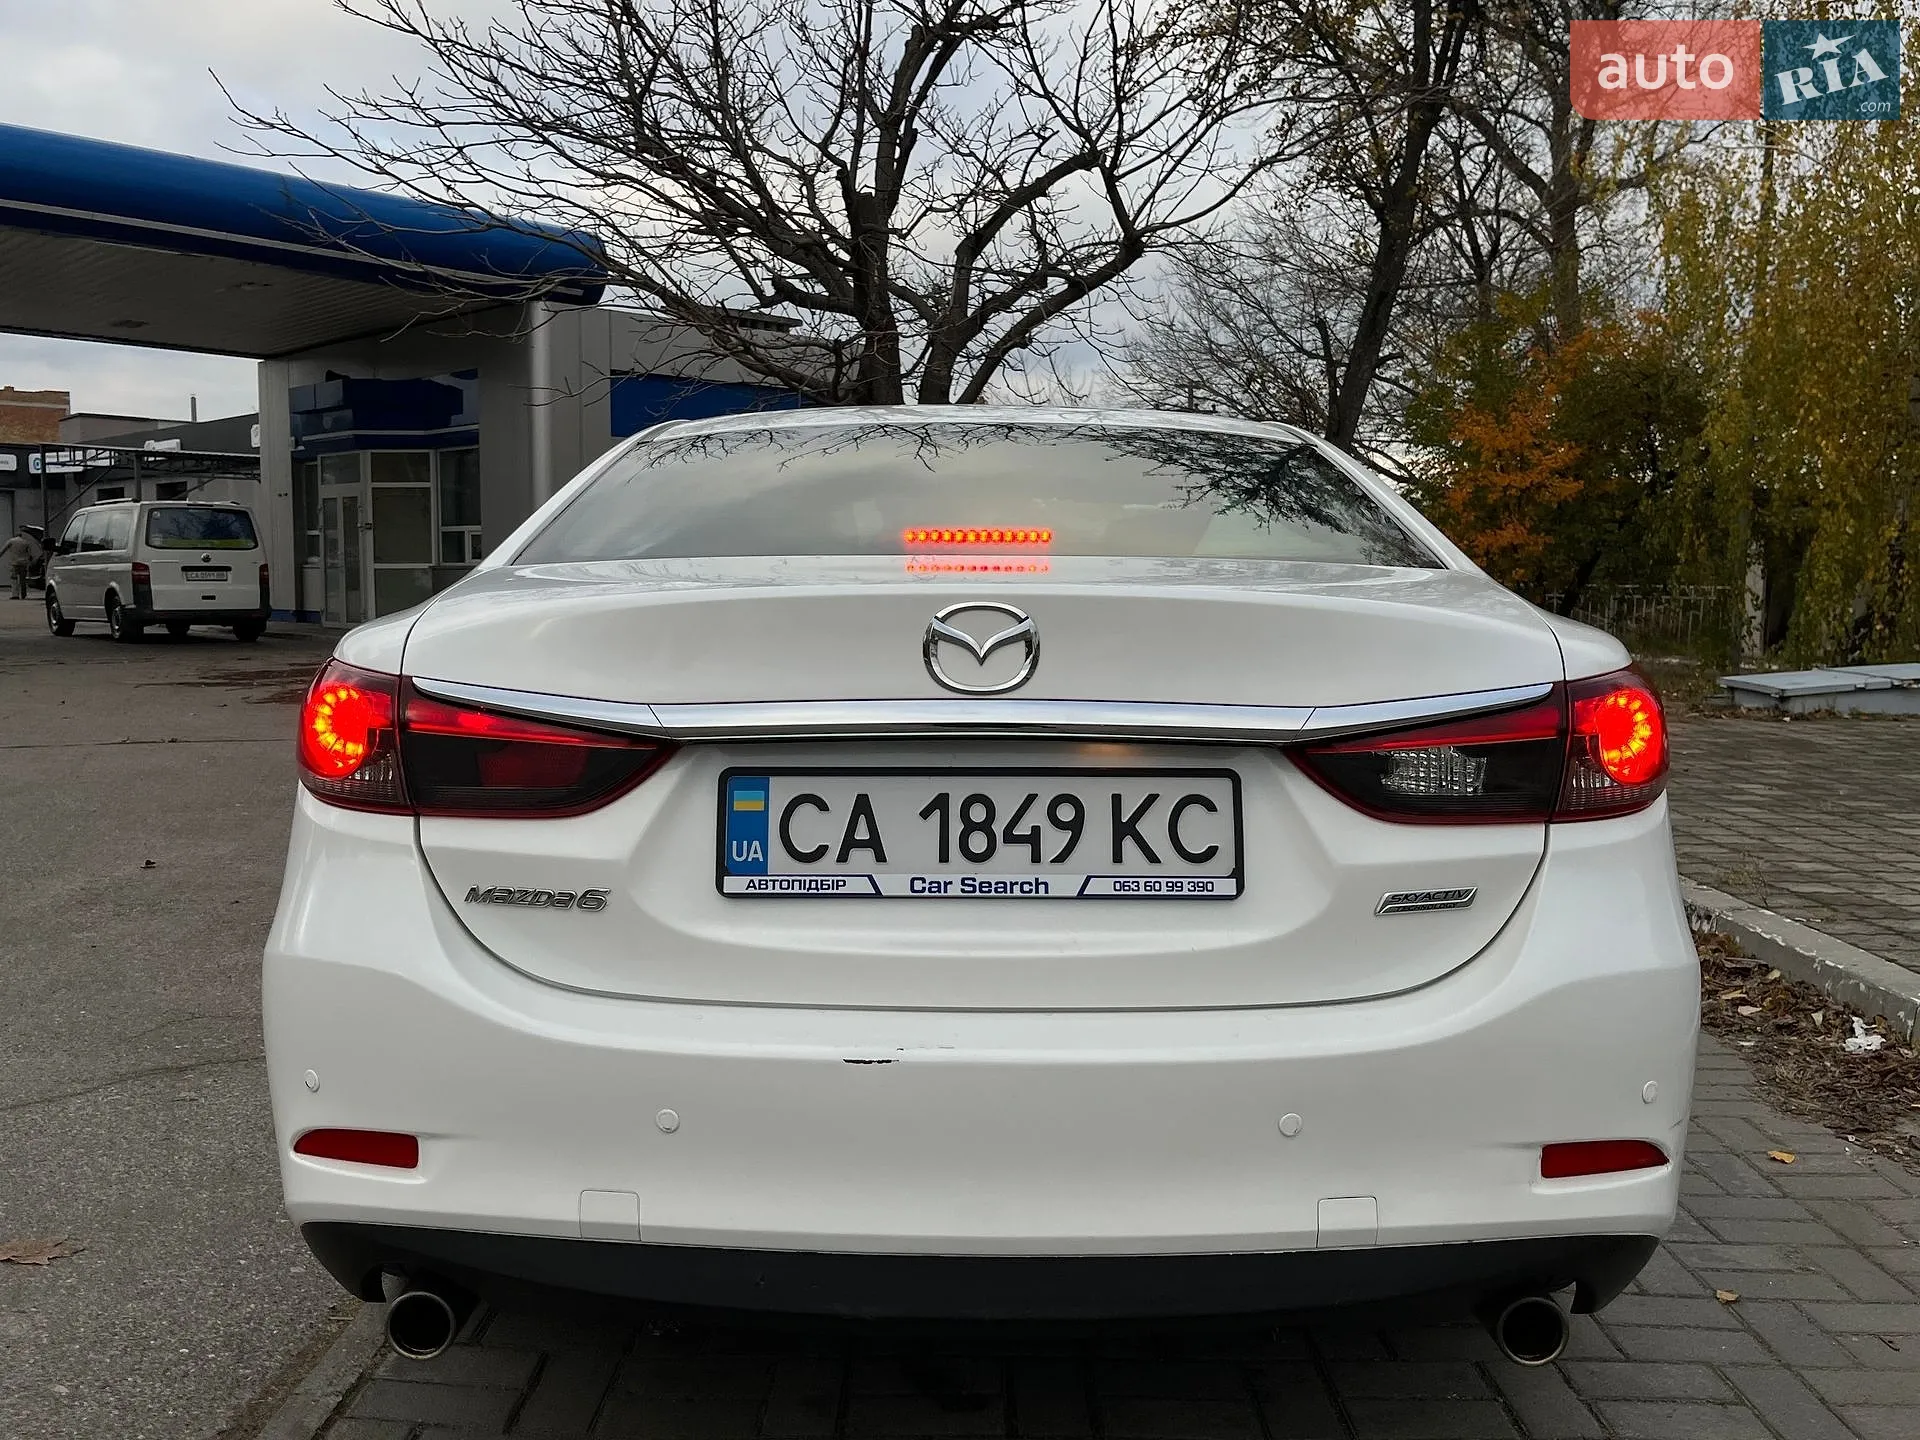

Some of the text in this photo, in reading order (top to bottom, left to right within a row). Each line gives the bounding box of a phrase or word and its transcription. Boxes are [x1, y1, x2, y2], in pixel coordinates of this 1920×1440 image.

[778, 792, 1220, 865] CA 1849 KC
[732, 840, 764, 862] UA
[745, 878, 847, 893] АВТОПІДБІР
[909, 876, 1050, 895] Car Search
[1112, 880, 1215, 893] 063 60 99 390
[1390, 889, 1470, 903] SKYACTIV
